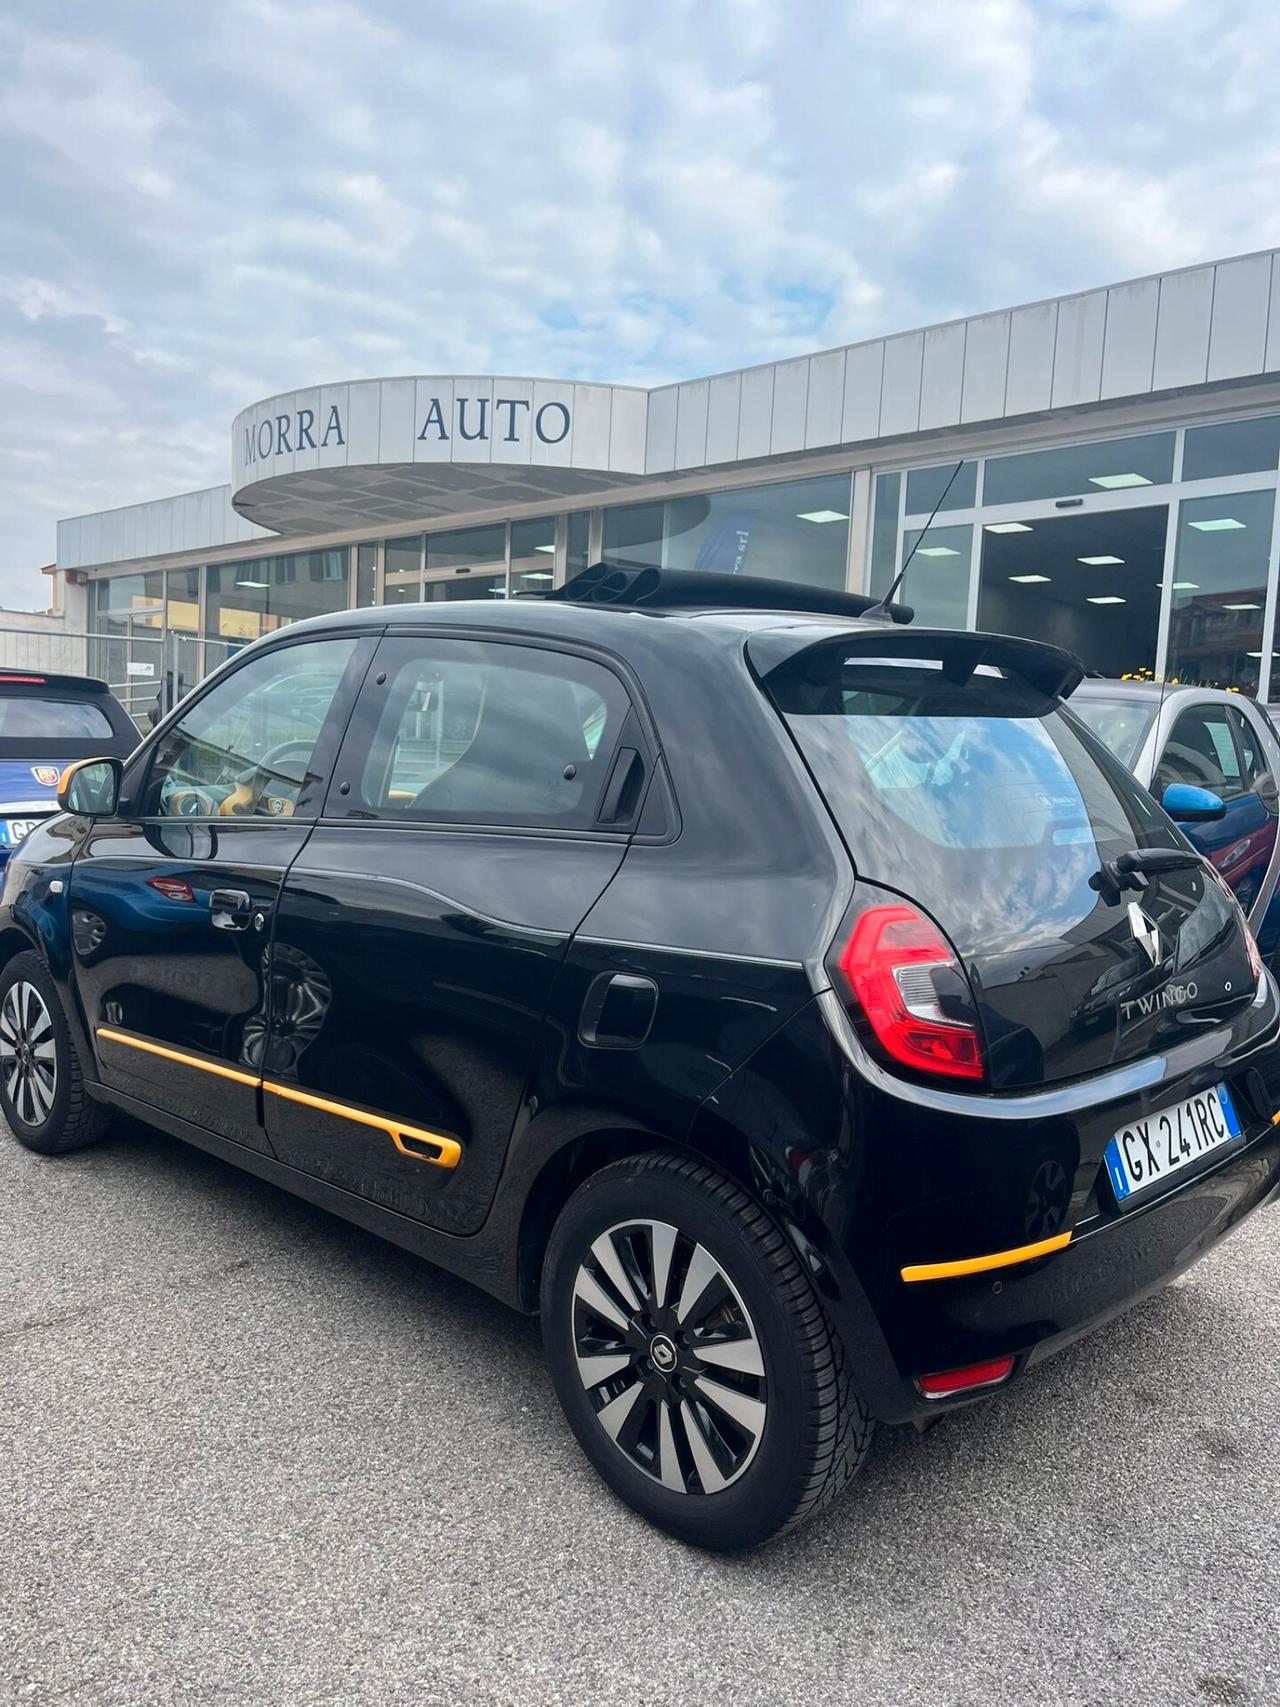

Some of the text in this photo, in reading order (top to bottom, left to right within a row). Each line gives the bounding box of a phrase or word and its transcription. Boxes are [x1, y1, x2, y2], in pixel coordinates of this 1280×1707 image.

[245, 398, 571, 467] MORRA AUTO
[736, 530, 749, 552] srl
[1120, 982, 1198, 1020] TWINGO
[1122, 1092, 1225, 1182] GX 241RC
